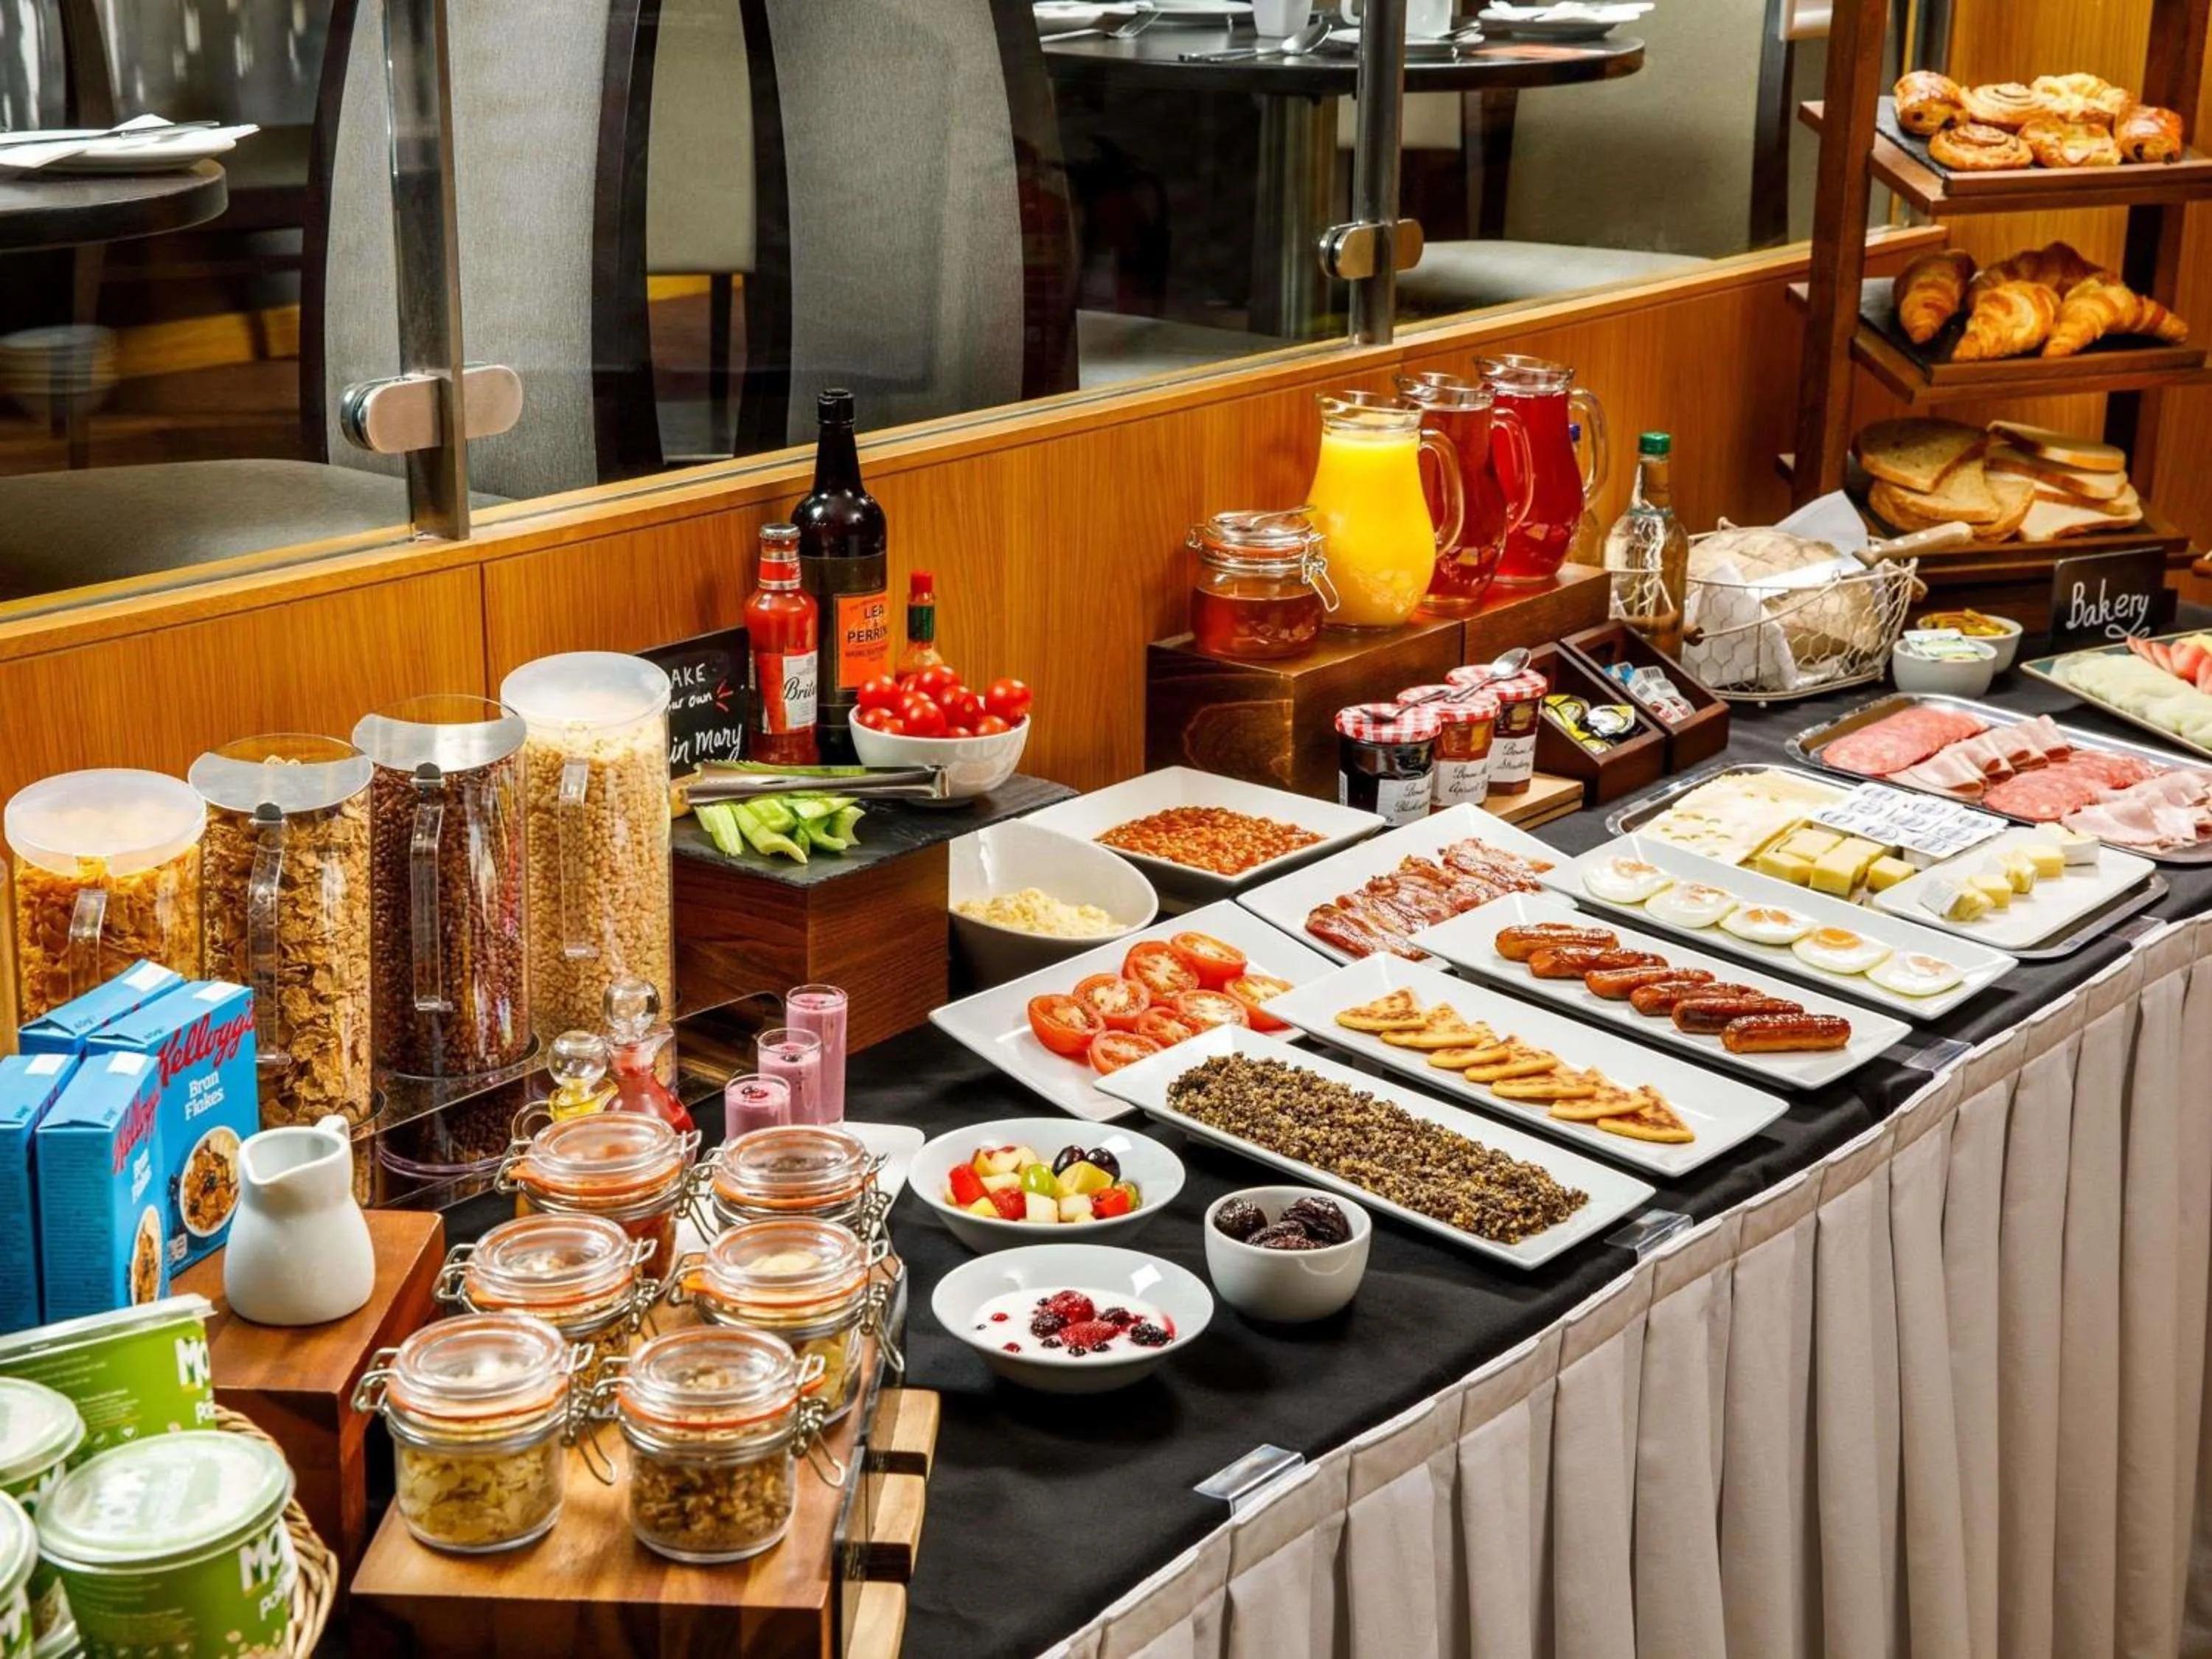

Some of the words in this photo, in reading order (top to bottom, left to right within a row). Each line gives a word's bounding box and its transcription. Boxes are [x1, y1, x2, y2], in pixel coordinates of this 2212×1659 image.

[2065, 577, 2151, 639] Bakery
[671, 663, 706, 688] AKE
[688, 692, 713, 709] own
[695, 723, 743, 762] Mary
[189, 1070, 220, 1099] Bran
[185, 1087, 224, 1121] Flakes
